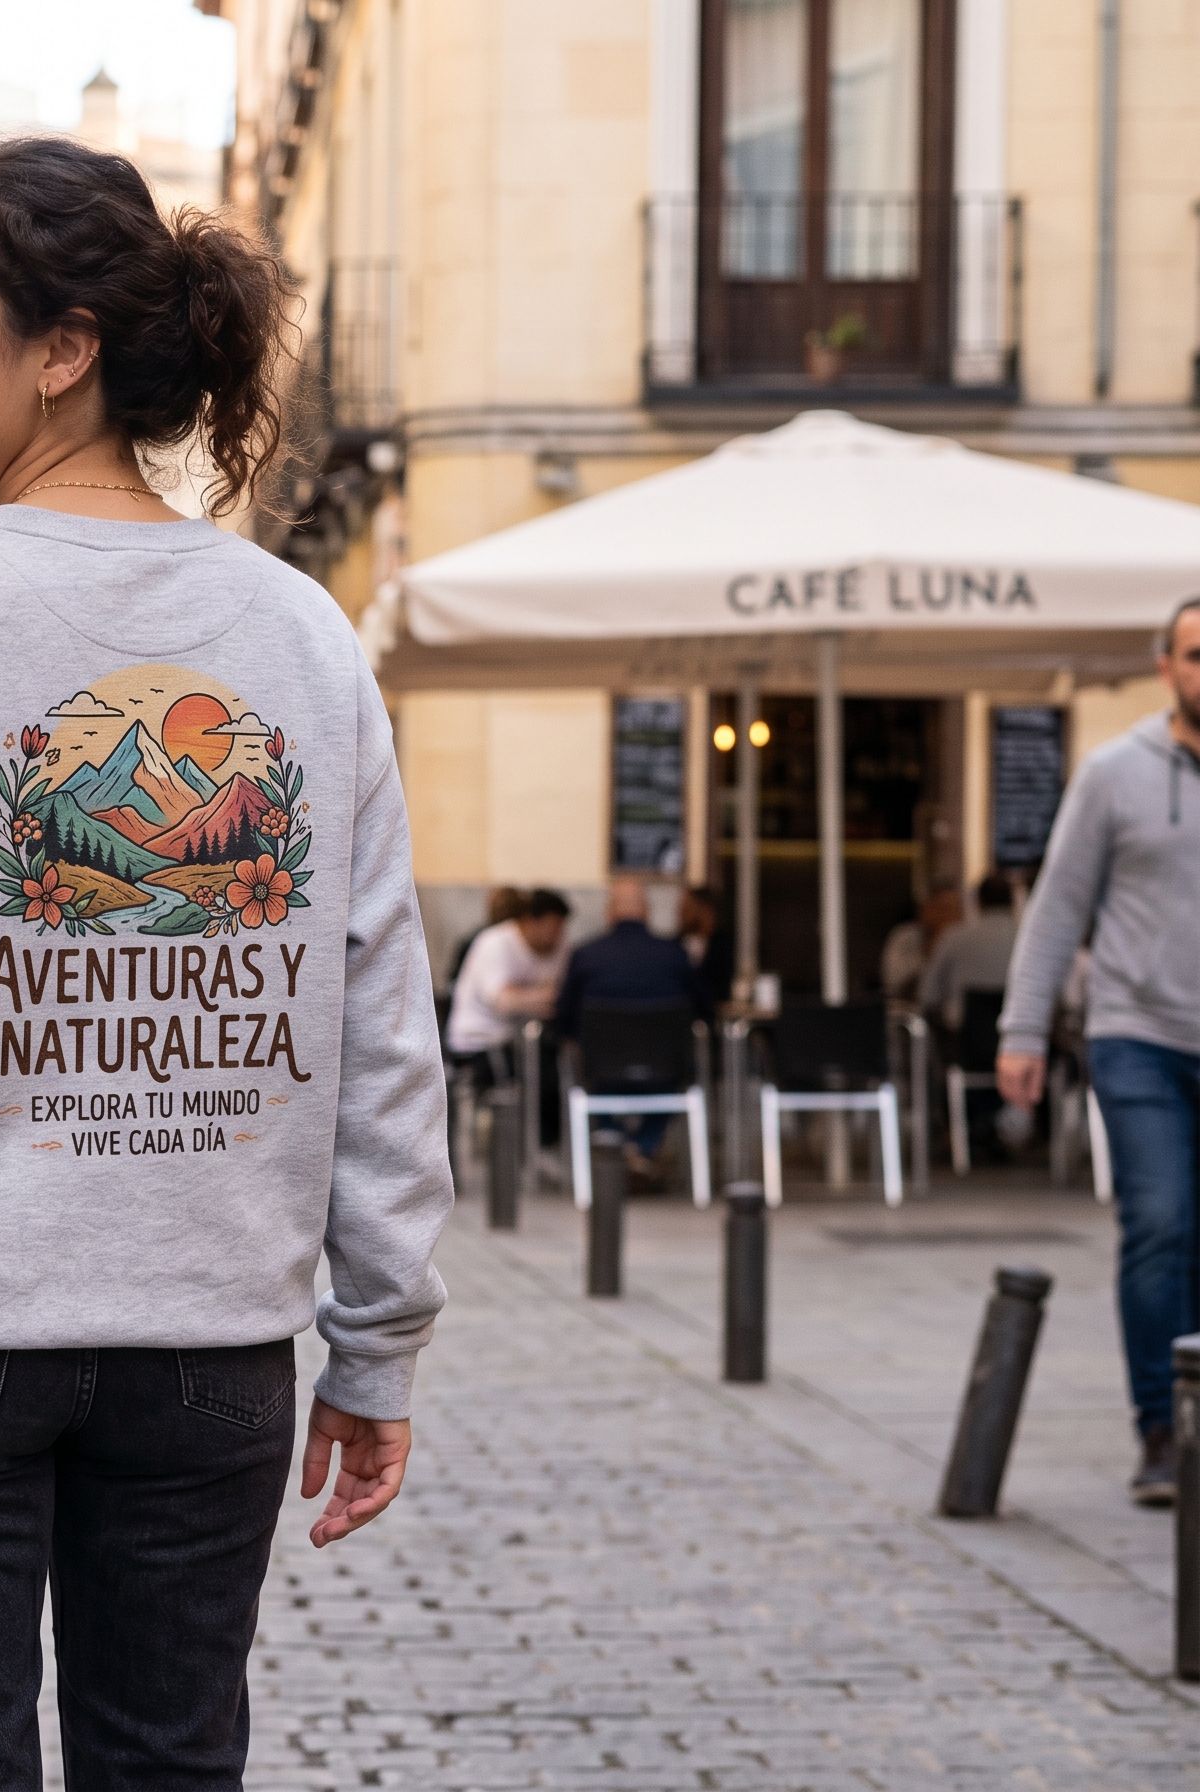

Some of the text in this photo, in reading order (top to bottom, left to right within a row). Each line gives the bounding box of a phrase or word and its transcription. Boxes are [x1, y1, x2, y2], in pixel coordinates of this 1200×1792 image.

[726, 565, 1038, 614] CAFÉ LUNA
[279, 943, 307, 998] Y
[0, 1011, 312, 1084] NATURALEZA
[30, 1088, 261, 1123] EXPLORA TU MUNDO
[71, 1121, 227, 1157] VIVE CADA DÍA
